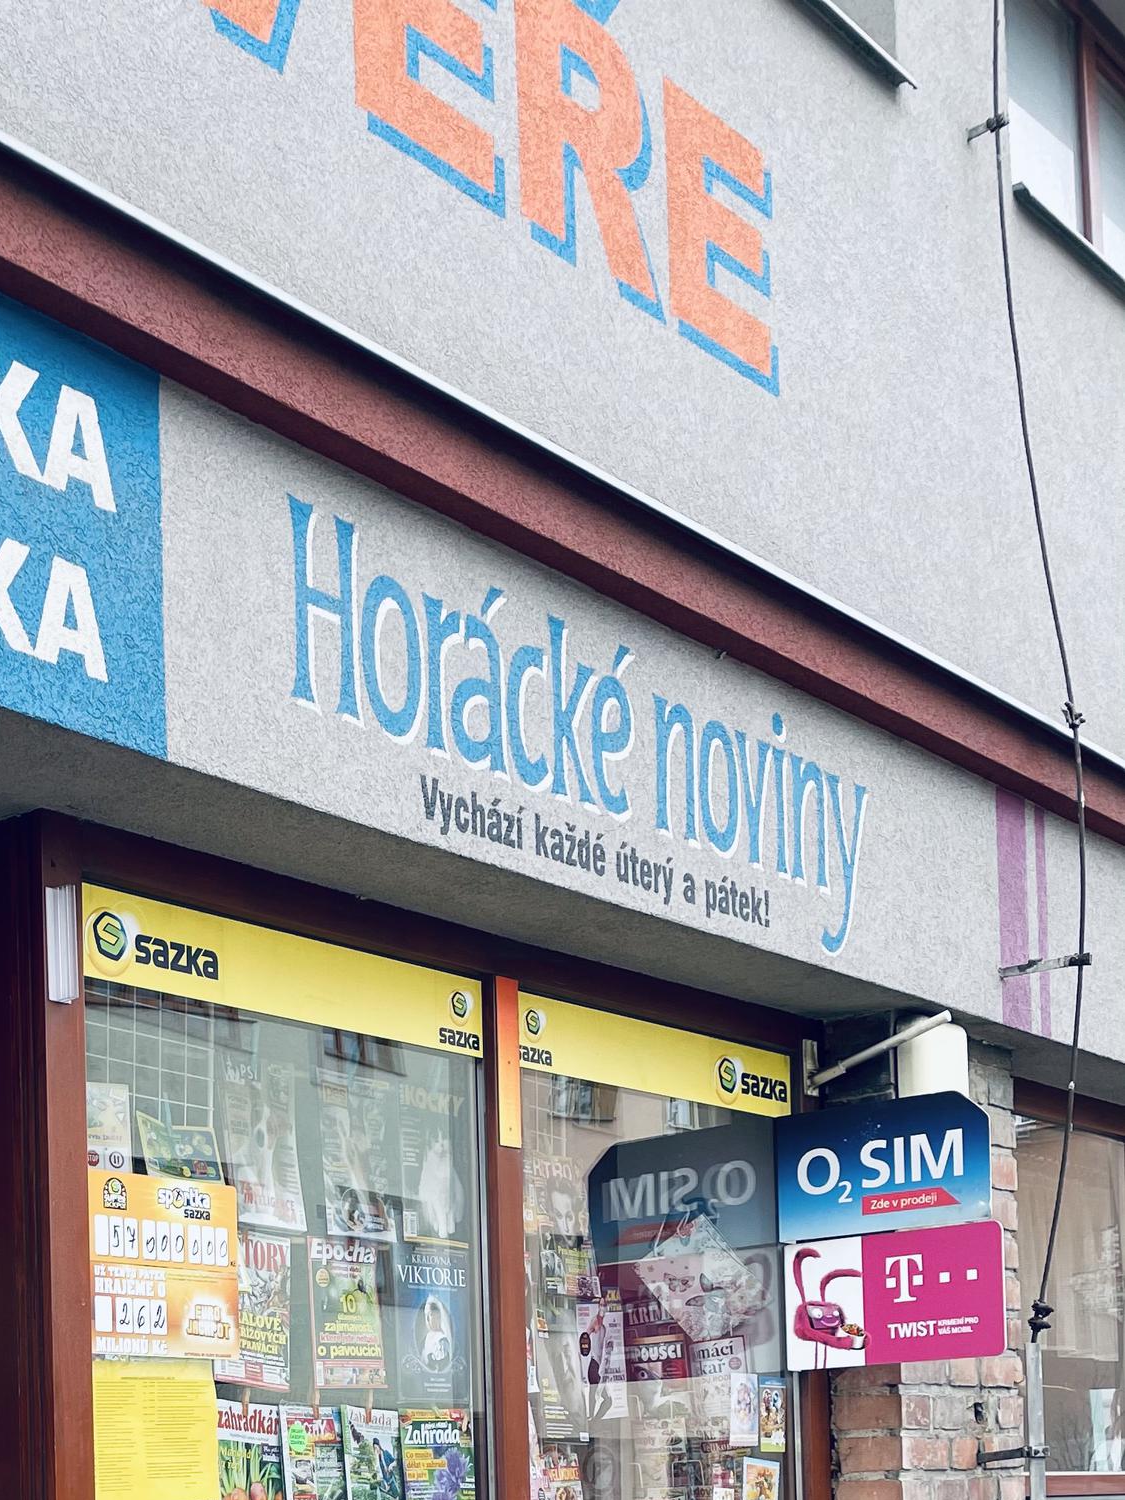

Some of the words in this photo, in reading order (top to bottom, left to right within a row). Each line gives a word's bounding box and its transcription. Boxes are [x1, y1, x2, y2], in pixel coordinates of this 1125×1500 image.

[286, 492, 635, 823] Horácké
[652, 692, 870, 955] noviny
[420, 774, 525, 850] Vychází
[535, 812, 606, 877] každé
[616, 841, 674, 906] úterý
[683, 871, 696, 906] a
[705, 875, 771, 928] pátek!
[859, 1128, 964, 1190] SIM
[157, 1187, 211, 1210] sportka
[870, 1198, 893, 1210] Zde
[901, 1192, 938, 1208] prodeji
[310, 1237, 375, 1266] Epocha
[396, 1263, 467, 1288] VIKTORIE
[887, 1320, 937, 1340] TWIST
[965, 1316, 979, 1325] PRO
[938, 1326, 951, 1336] VÁŠ
[952, 1326, 973, 1334] MOBIL
[318, 1345, 327, 1357] o
[330, 1343, 383, 1360] pavoucích
[404, 1422, 461, 1446] Zahrada
